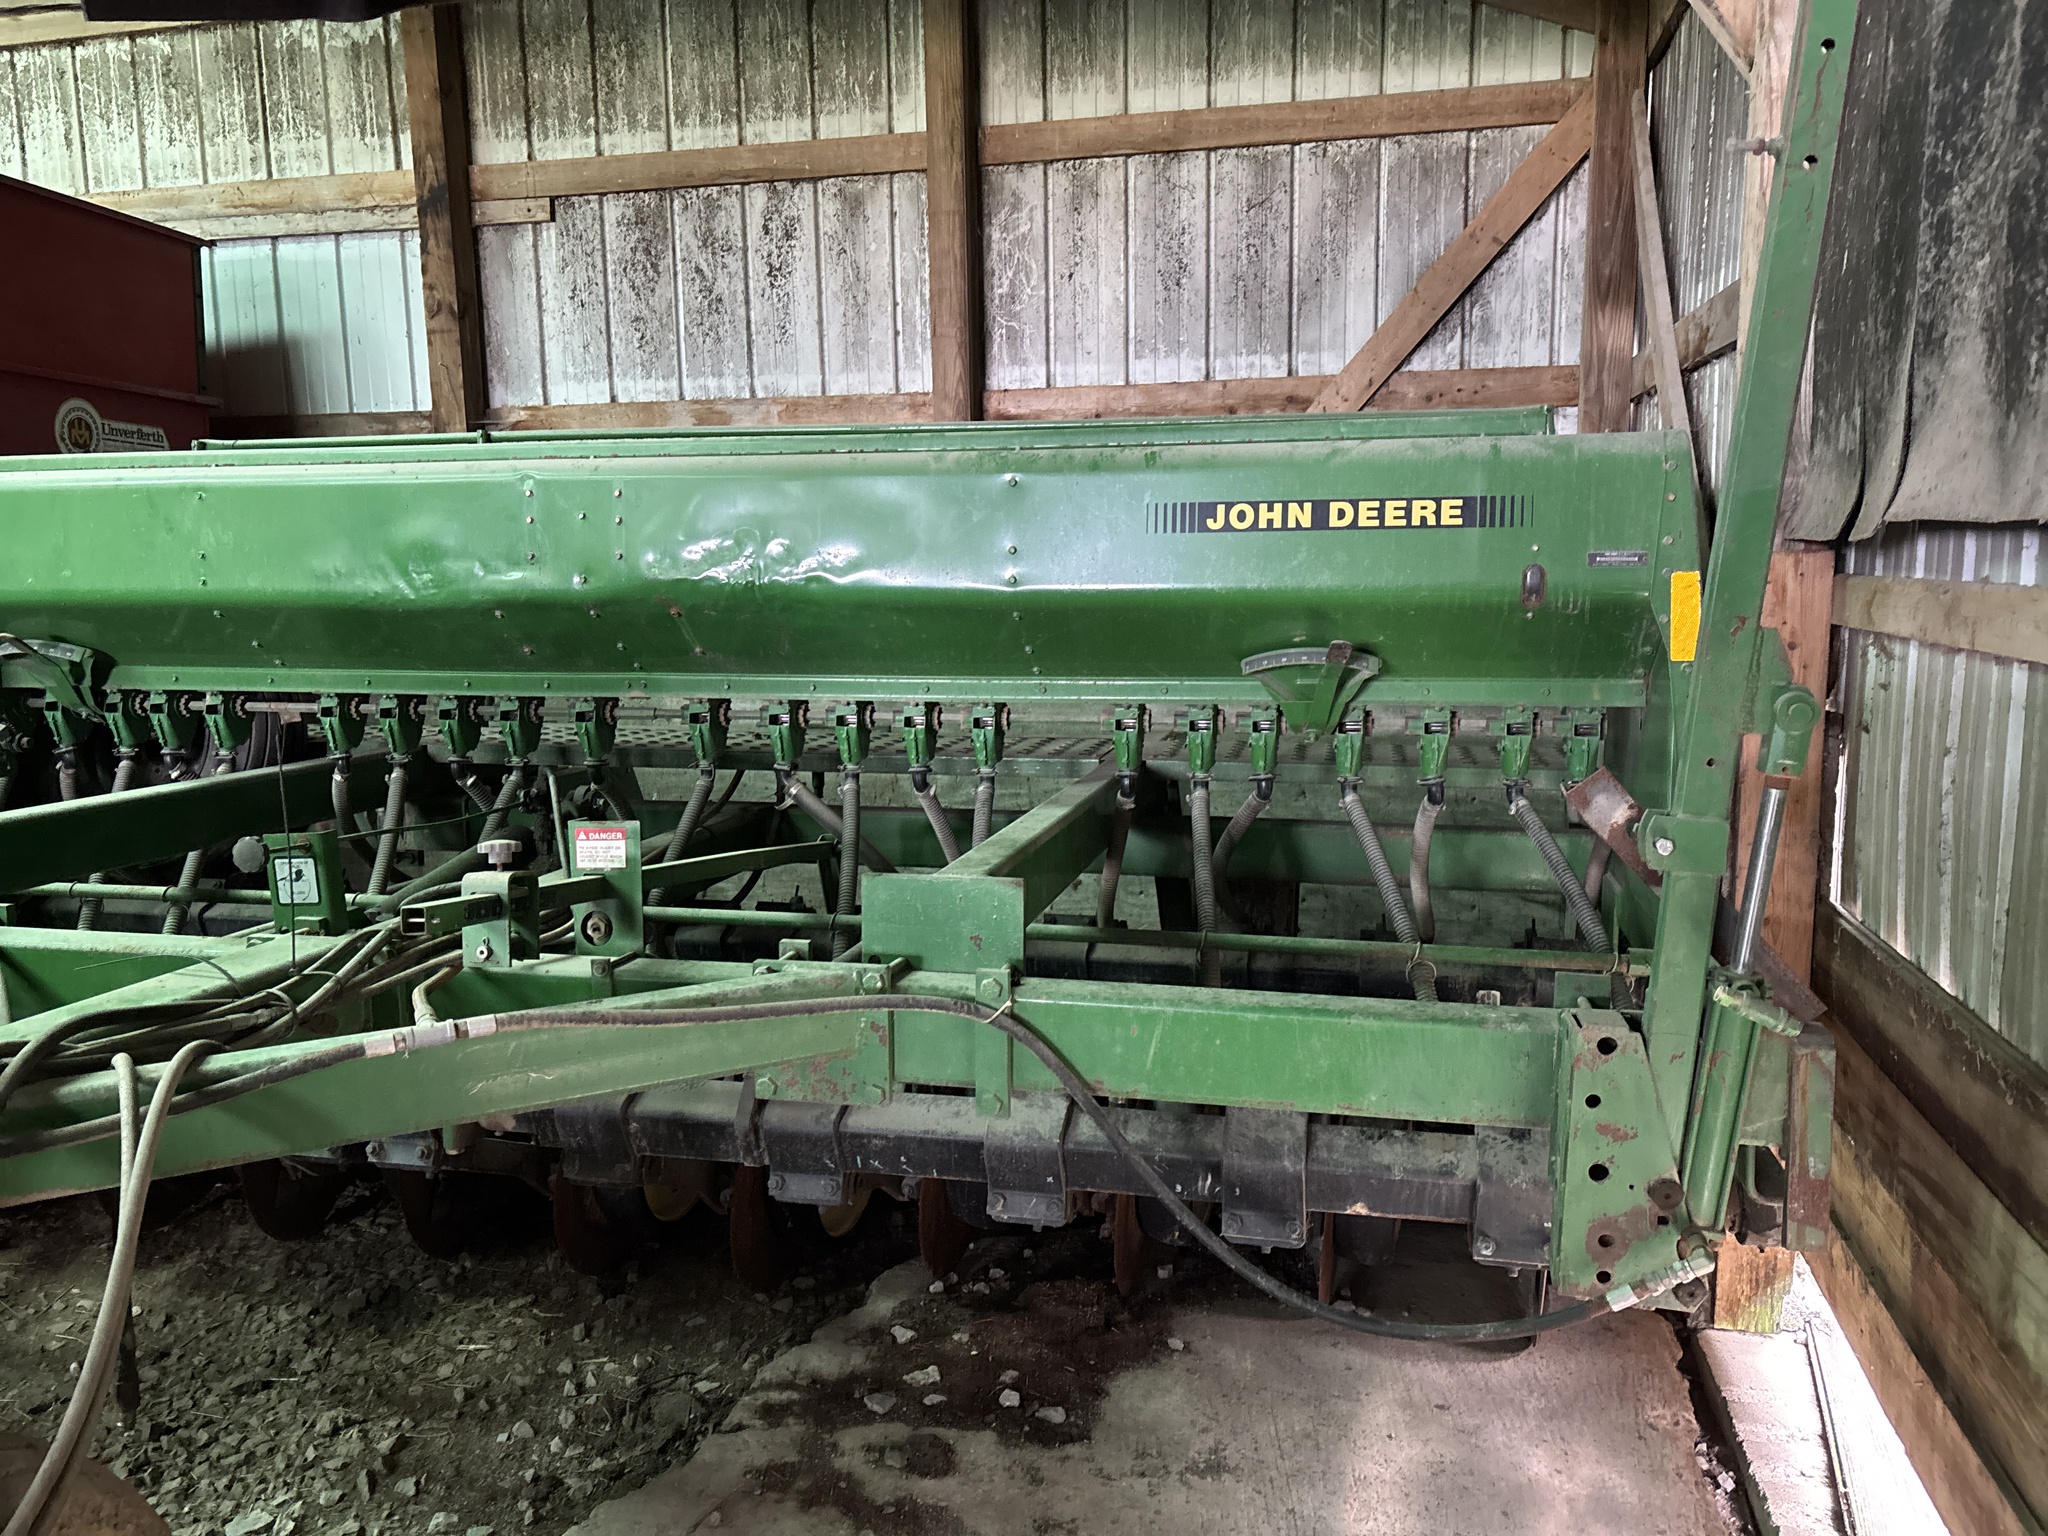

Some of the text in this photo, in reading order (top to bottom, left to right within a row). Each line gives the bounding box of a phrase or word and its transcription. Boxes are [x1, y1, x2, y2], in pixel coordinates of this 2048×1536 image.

[101, 423, 164, 443] Unverferth
[1206, 498, 1464, 530] JOHN DEERE
[588, 832, 623, 840] DANGER
